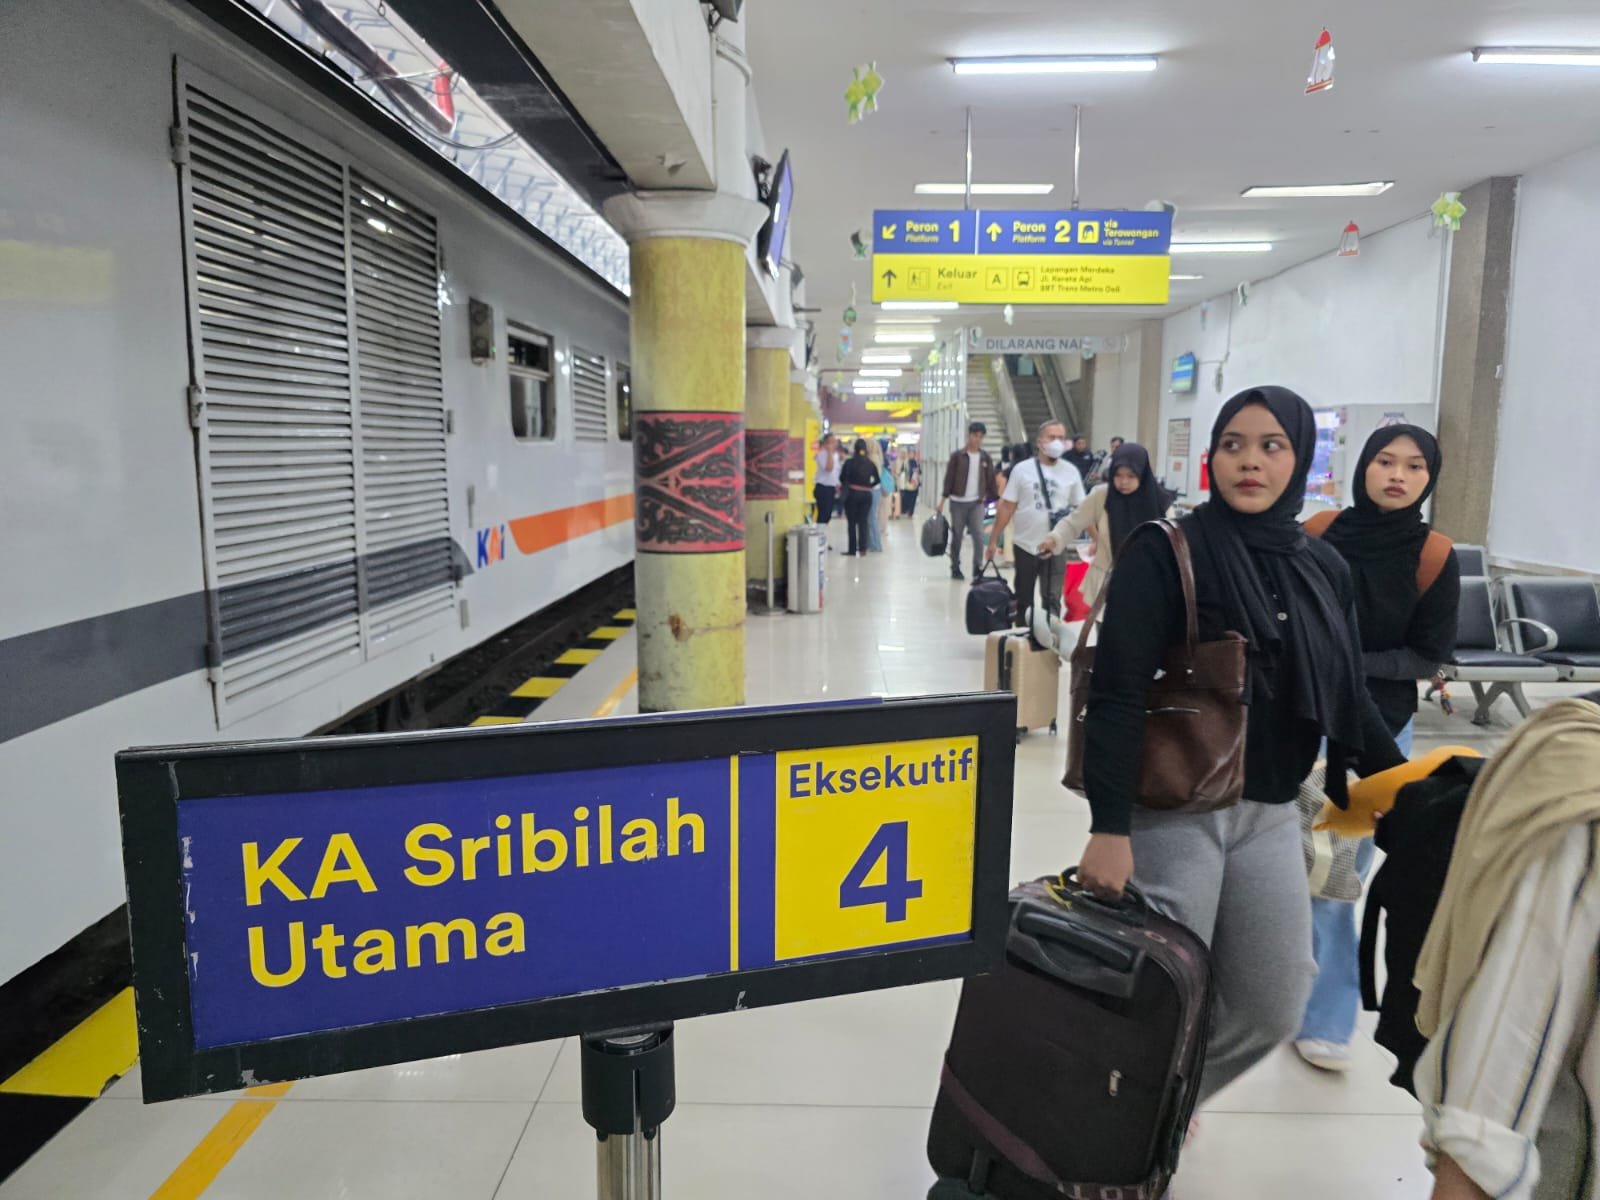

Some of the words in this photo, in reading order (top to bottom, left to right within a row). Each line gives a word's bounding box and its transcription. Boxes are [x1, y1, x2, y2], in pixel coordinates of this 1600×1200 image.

[905, 220, 939, 233] Peron
[948, 219, 960, 242] 1
[1013, 220, 1046, 233] Peron
[1054, 219, 1071, 243] 2
[1104, 218, 1118, 229] via
[904, 233, 939, 243] Platform
[1012, 233, 1046, 243] Platform
[1104, 228, 1159, 239] Terowongan
[937, 268, 978, 279] Keluar
[986, 338, 1055, 350] DILARANG
[790, 748, 973, 798] Eksekutif
[243, 833, 377, 906] KA
[404, 797, 705, 887] Sribilah
[839, 821, 923, 923] 4
[247, 911, 525, 988] Utama
